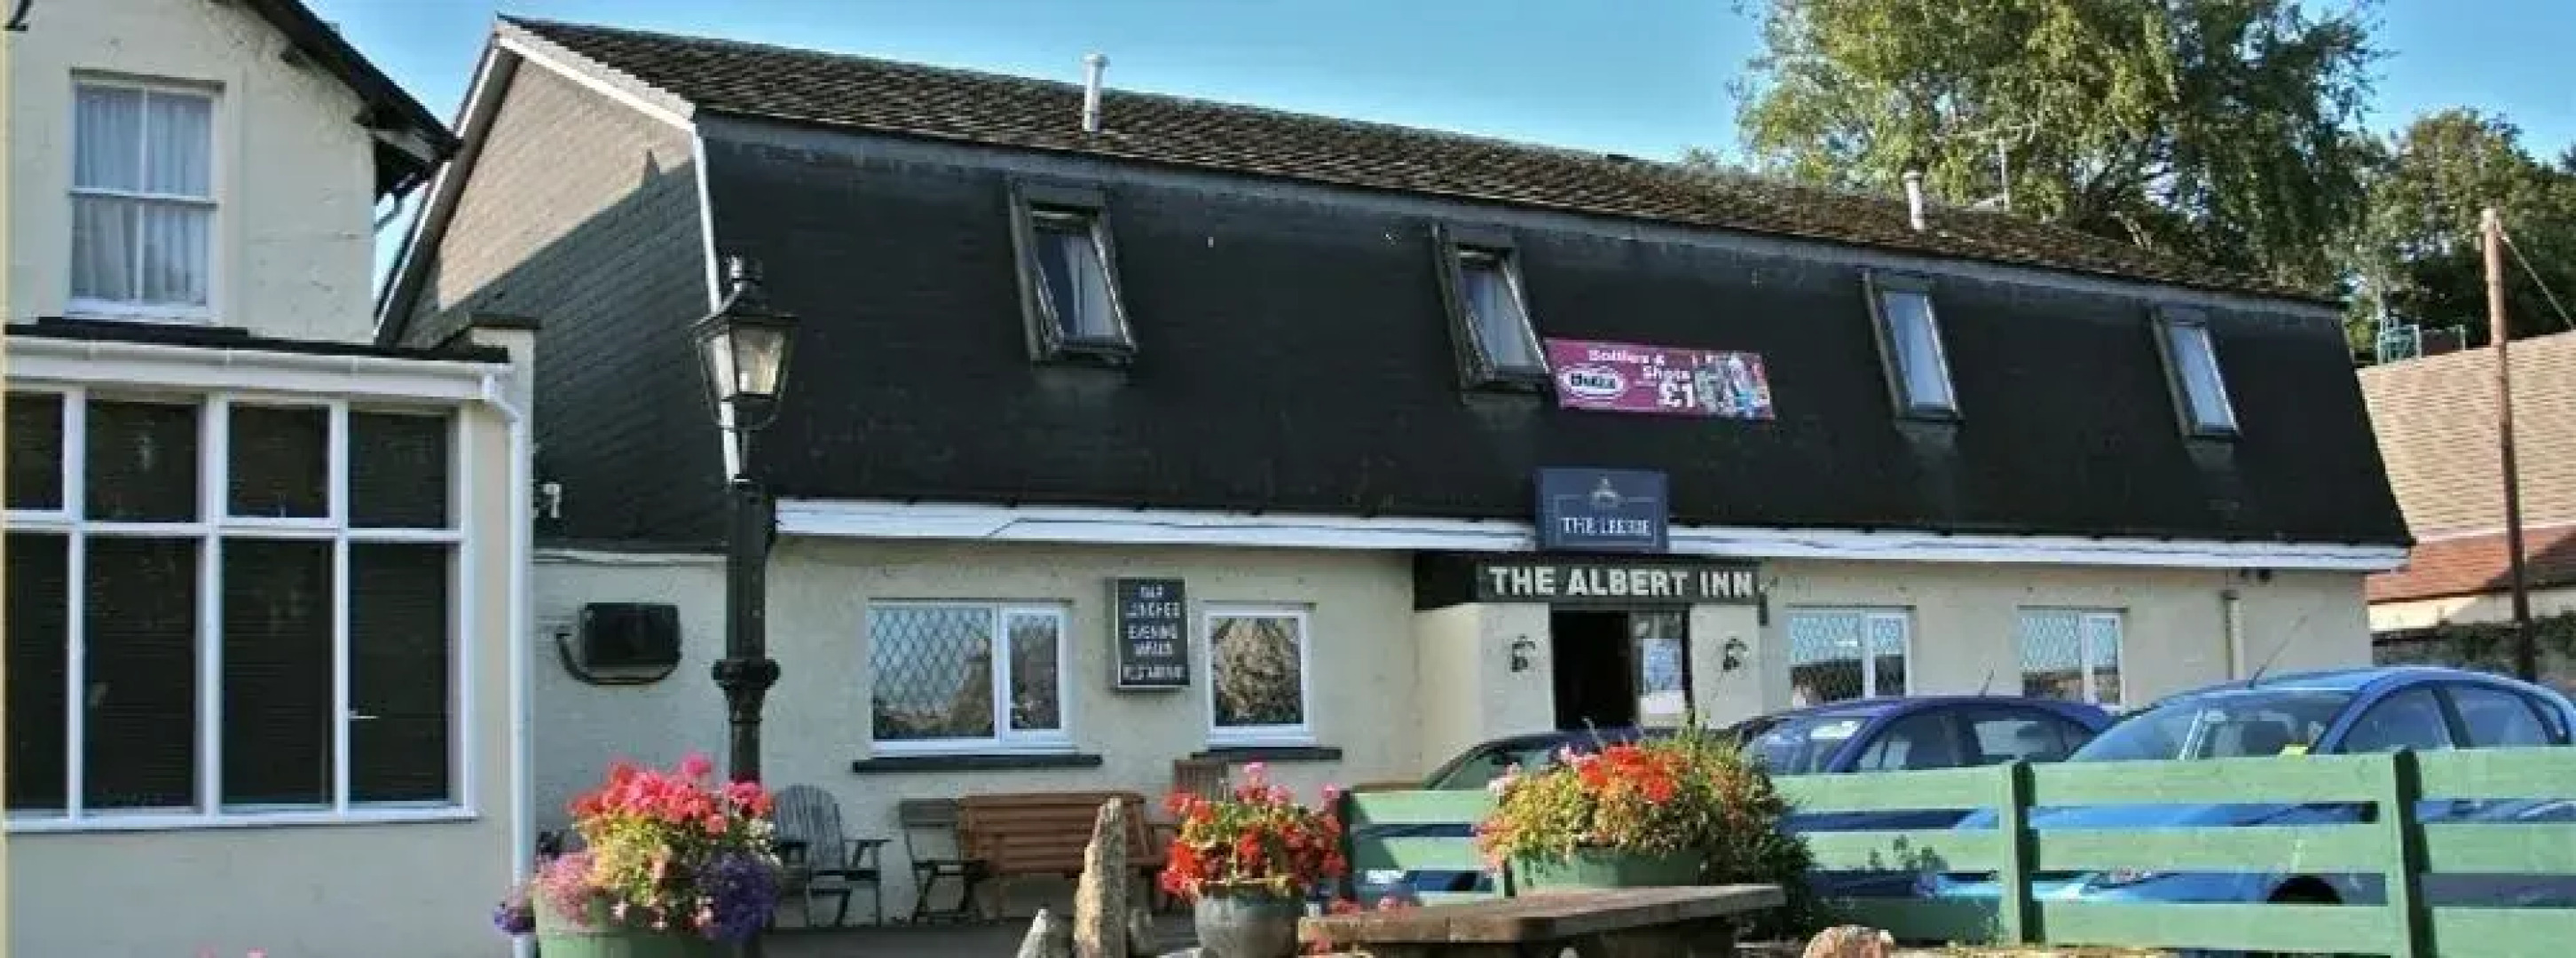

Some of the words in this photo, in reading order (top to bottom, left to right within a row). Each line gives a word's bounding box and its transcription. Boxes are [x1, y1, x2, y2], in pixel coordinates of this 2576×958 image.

[1658, 381, 1695, 408] £1
[1562, 516, 1595, 534] THE
[1488, 565, 1556, 597] THE
[1566, 567, 1689, 598] ALBERT
[1698, 569, 1754, 598] INN
